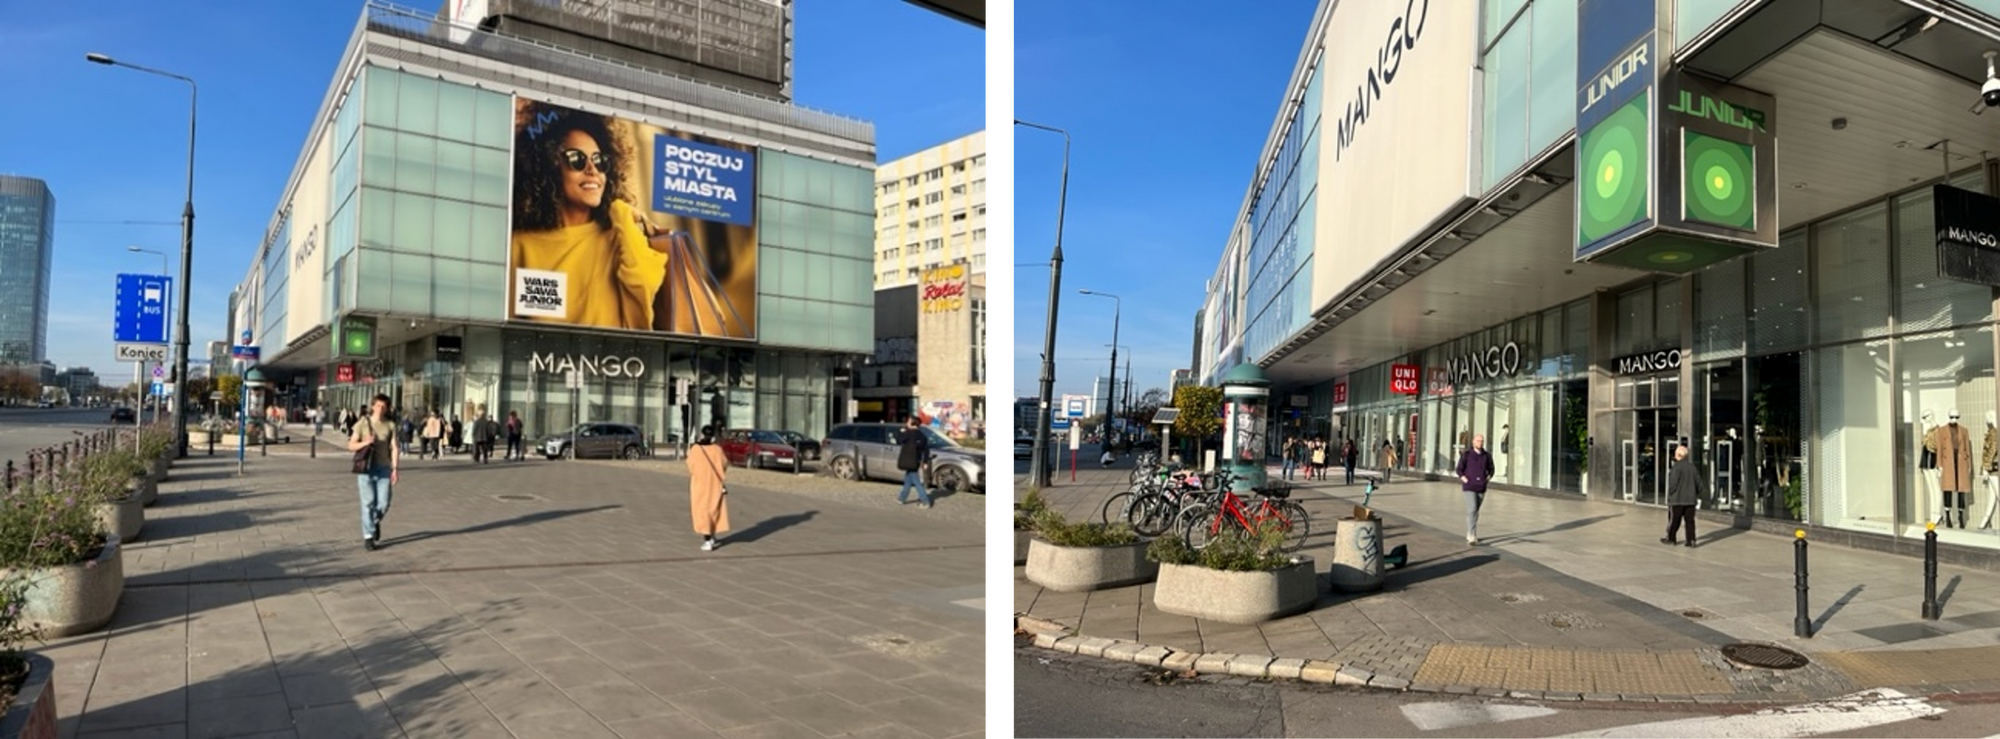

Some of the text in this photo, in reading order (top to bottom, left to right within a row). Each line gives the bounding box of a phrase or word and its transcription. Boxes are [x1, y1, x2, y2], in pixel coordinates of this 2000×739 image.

[1581, 43, 1648, 113] JUNIOR
[1668, 90, 1766, 133] JUNIOR
[665, 144, 744, 172] POCZUJ
[665, 161, 718, 183] STYL
[664, 176, 737, 202] MIASTA
[1948, 225, 1997, 248] MANGO
[523, 276, 559, 288] WARS
[525, 285, 559, 297] SAWA
[143, 306, 161, 315] BUS
[519, 294, 563, 307] JUNIOR
[120, 346, 164, 361] Koniec
[530, 351, 645, 378] MANGO
[1446, 342, 1520, 384] MANGO
[1619, 349, 1681, 375] MANGO
[1395, 367, 1416, 379] UNI
[1394, 379, 1417, 392] QLO
